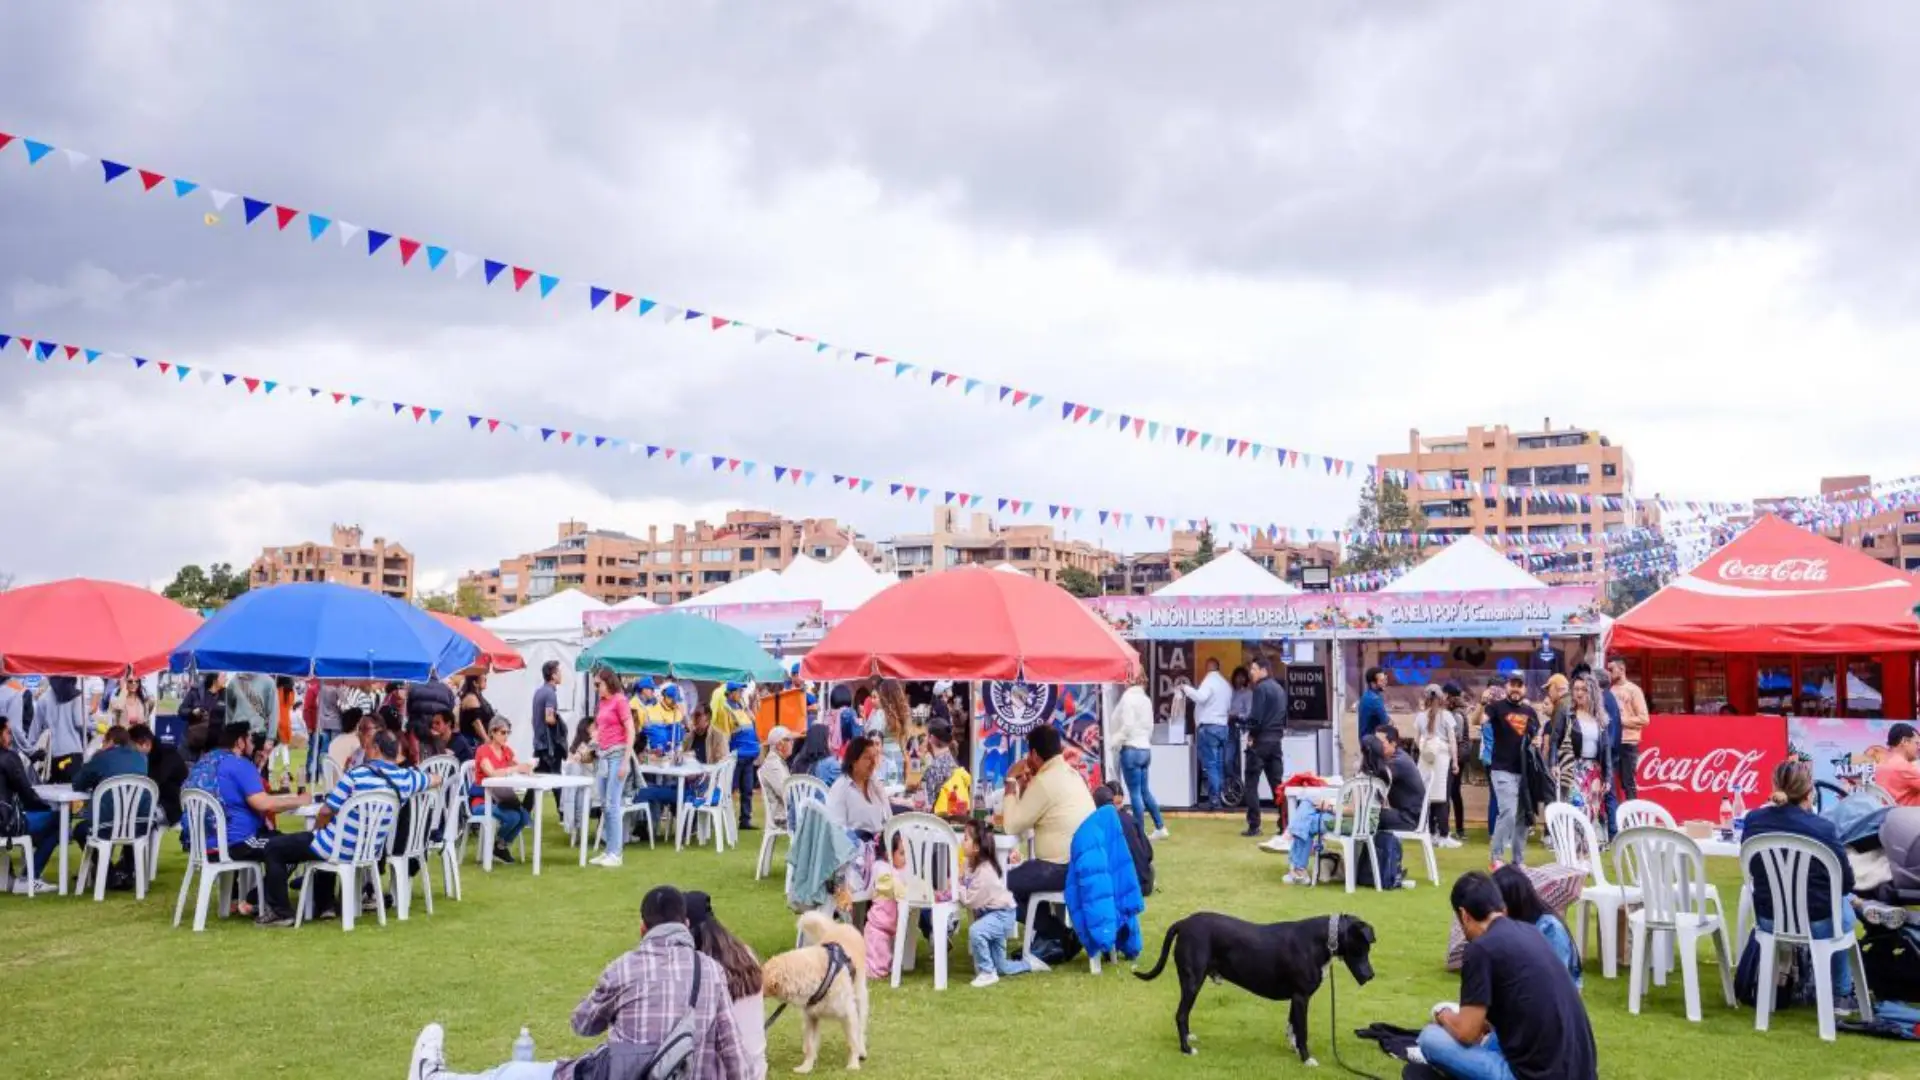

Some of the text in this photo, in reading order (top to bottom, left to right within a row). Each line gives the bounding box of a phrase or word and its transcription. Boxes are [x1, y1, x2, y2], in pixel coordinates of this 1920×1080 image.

[1718, 558, 1829, 581] Coca-Cola
[1189, 607, 1225, 627] LIBRE
[1157, 646, 1186, 670] LA
[1289, 671, 1323, 683] UNION
[1289, 685, 1316, 697] LIBRE
[1635, 746, 1767, 793] Coca-Cola
